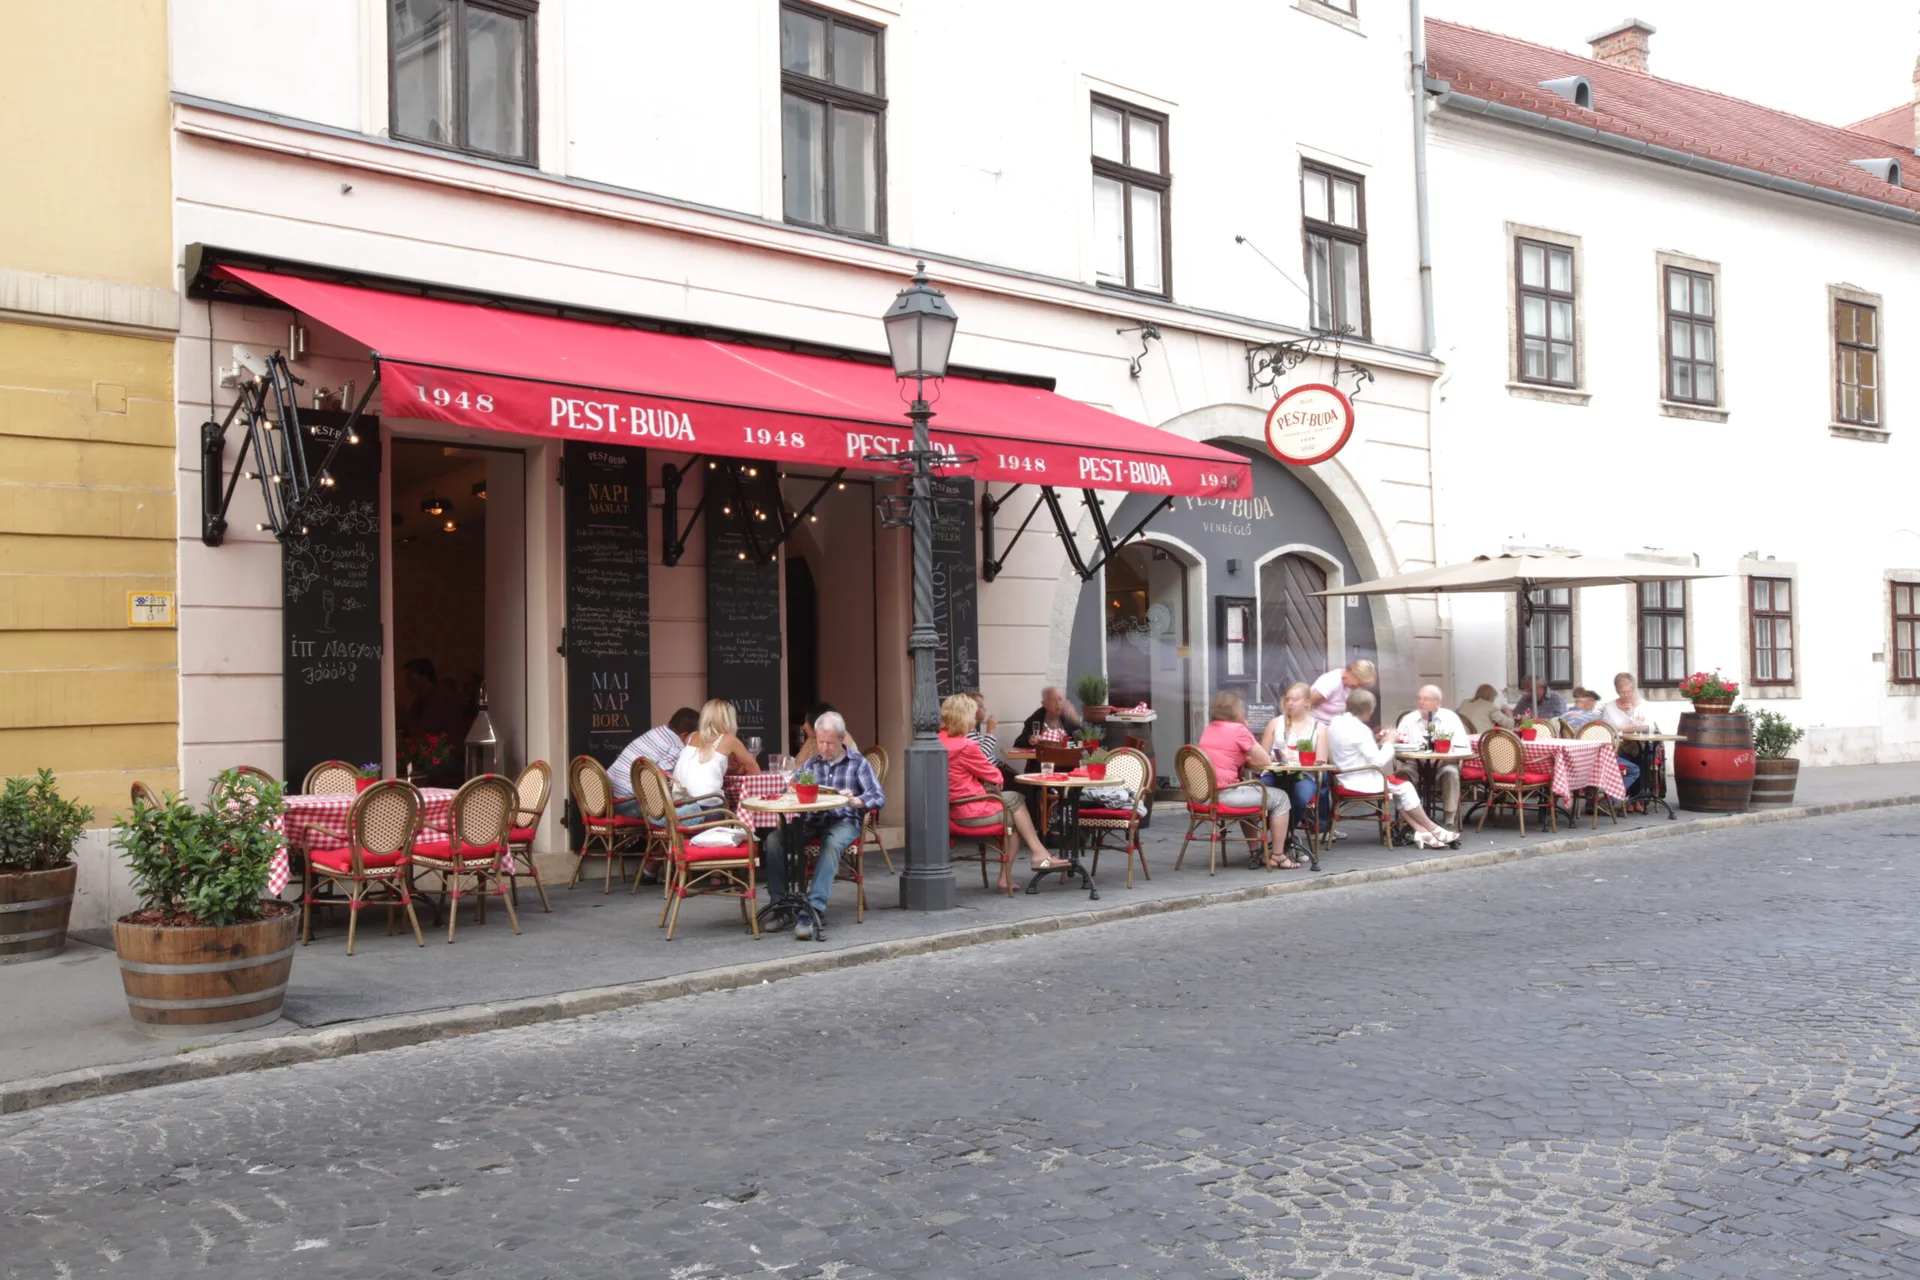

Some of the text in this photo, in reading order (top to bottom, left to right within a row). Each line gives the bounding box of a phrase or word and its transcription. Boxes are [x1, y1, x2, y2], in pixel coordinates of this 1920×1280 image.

[415, 385, 494, 413] 1948
[743, 427, 805, 448] 1948
[846, 431, 961, 468] PEST·DA
[997, 454, 1046, 472] 1948
[1200, 473, 1239, 488] 1948
[588, 483, 628, 502] NAPI
[1203, 522, 1252, 536] VENDÉGLŐ
[322, 641, 382, 660] NAGYON
[591, 672, 628, 690] MAI
[593, 692, 629, 710] NAP
[592, 714, 630, 727] BORA
